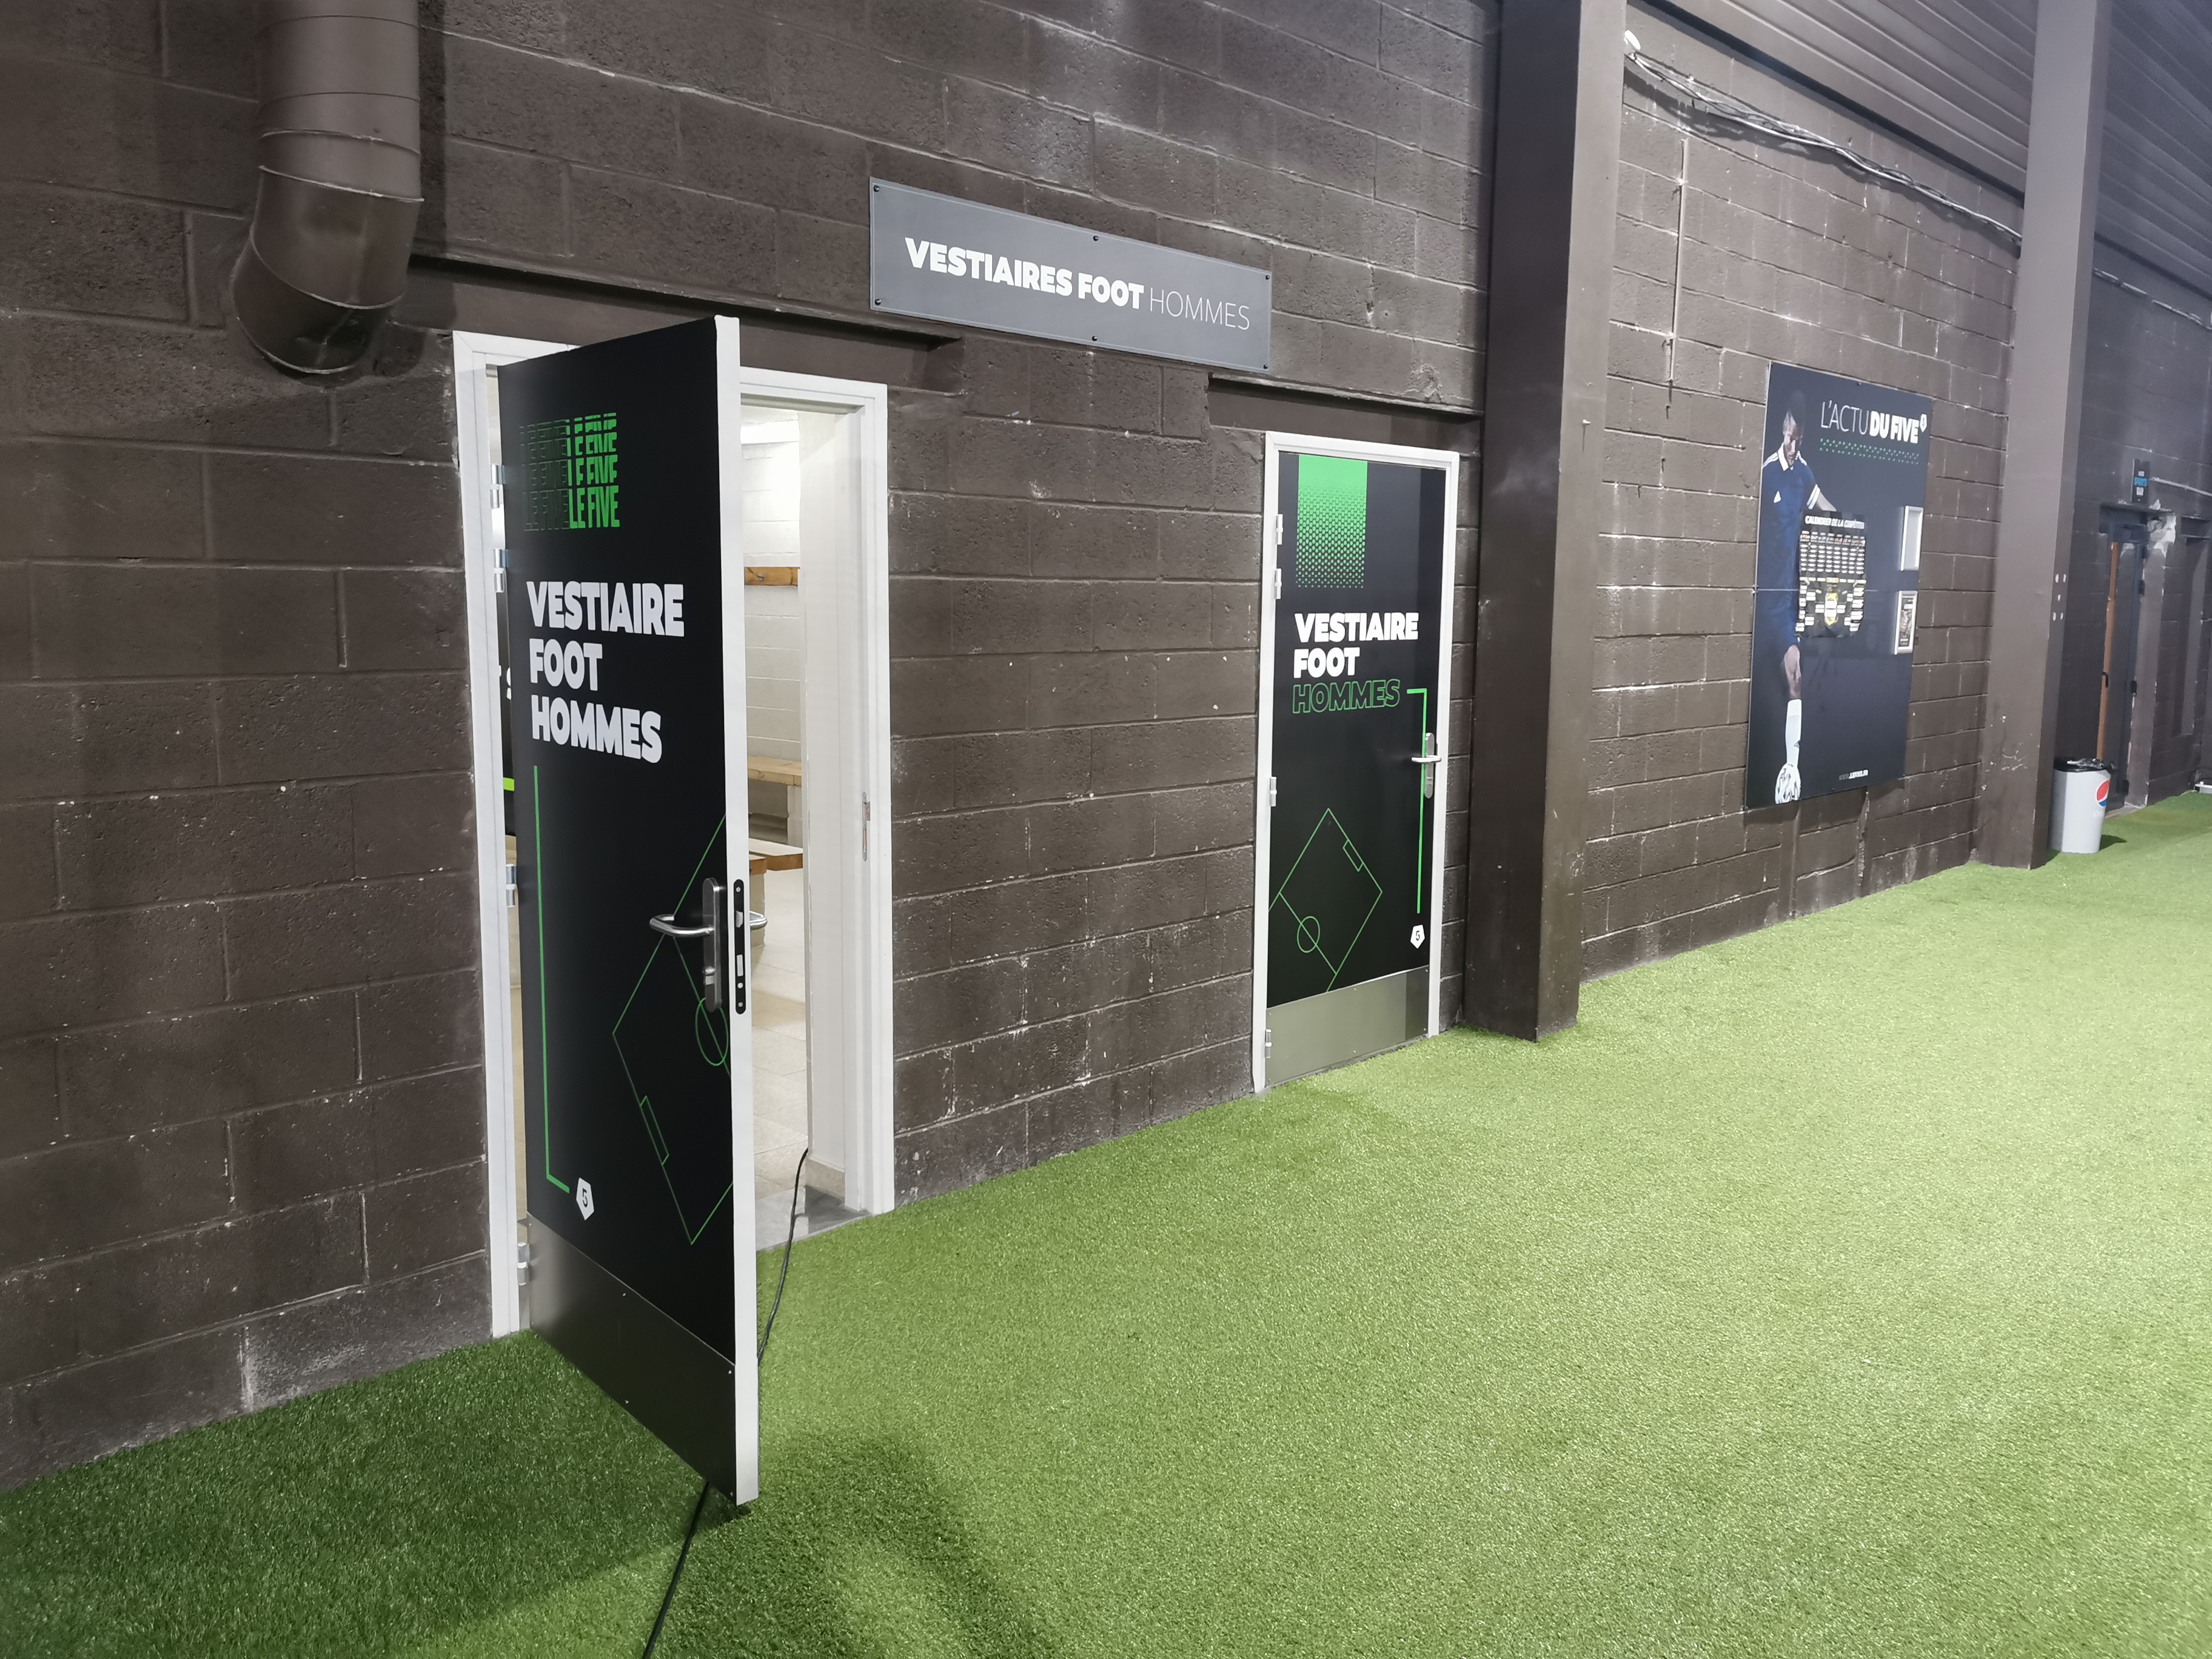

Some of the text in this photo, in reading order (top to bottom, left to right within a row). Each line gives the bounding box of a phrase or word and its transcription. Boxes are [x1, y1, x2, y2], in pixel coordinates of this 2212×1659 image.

[905, 237, 1250, 330] VESTIAIRES FOOT HOMMES
[1821, 400, 1920, 444] L'ACTU DU FIVE
[569, 485, 620, 529] LE FIVE
[526, 581, 685, 637] VESTIAIRE
[1295, 612, 1419, 643] VESTIAIRE
[529, 638, 603, 691] FOOT
[1293, 647, 1360, 679] FOOT
[1293, 679, 1401, 714] HOMMES
[531, 694, 662, 763] HOMMES
[582, 1188, 588, 1208] 5
